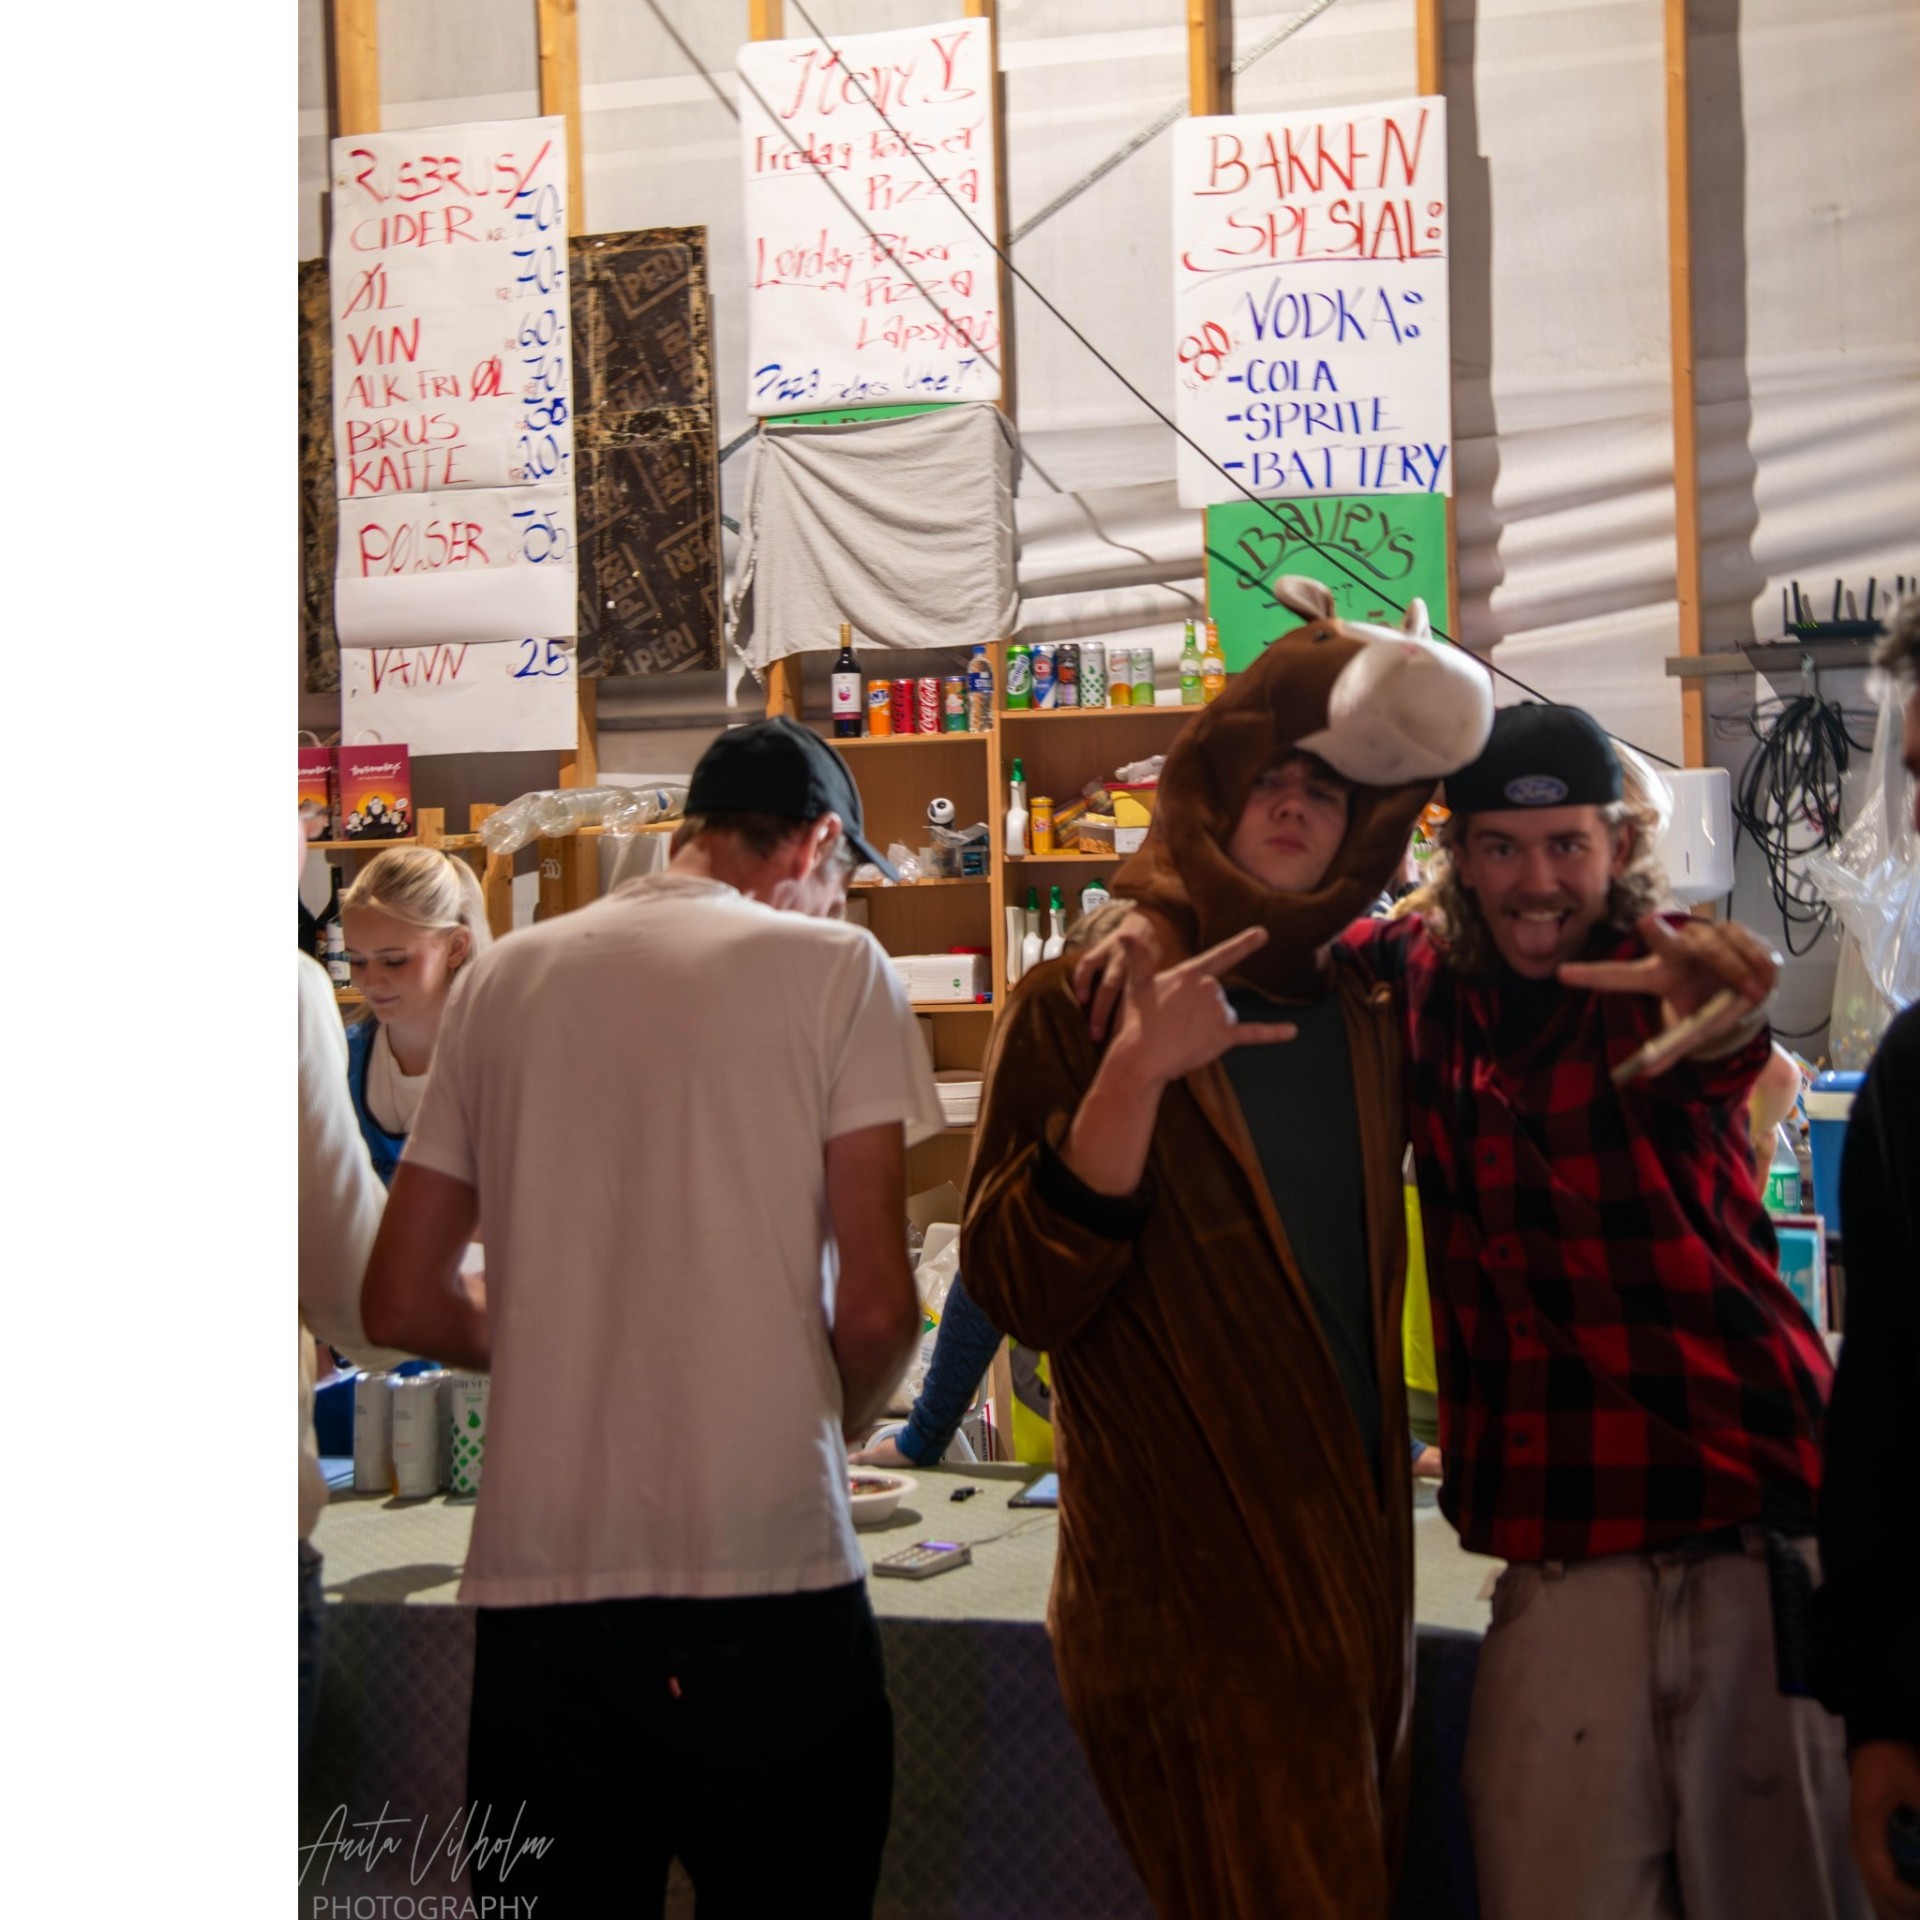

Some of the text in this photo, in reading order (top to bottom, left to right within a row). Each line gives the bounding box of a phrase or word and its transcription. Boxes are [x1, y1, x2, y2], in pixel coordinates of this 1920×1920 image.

[1192, 108, 1430, 200] BAKKEN
[867, 168, 979, 211] Pizza
[351, 205, 480, 251] CIDER
[1215, 199, 1445, 262] SPESIAL:
[342, 262, 404, 319] ØL
[860, 269, 974, 307] Pizza
[1245, 276, 1424, 345] VODKA:
[346, 318, 420, 366] VIN
[345, 413, 460, 458] BRUS
[348, 443, 474, 498] KAFFE
[369, 638, 570, 695] VANN 25
